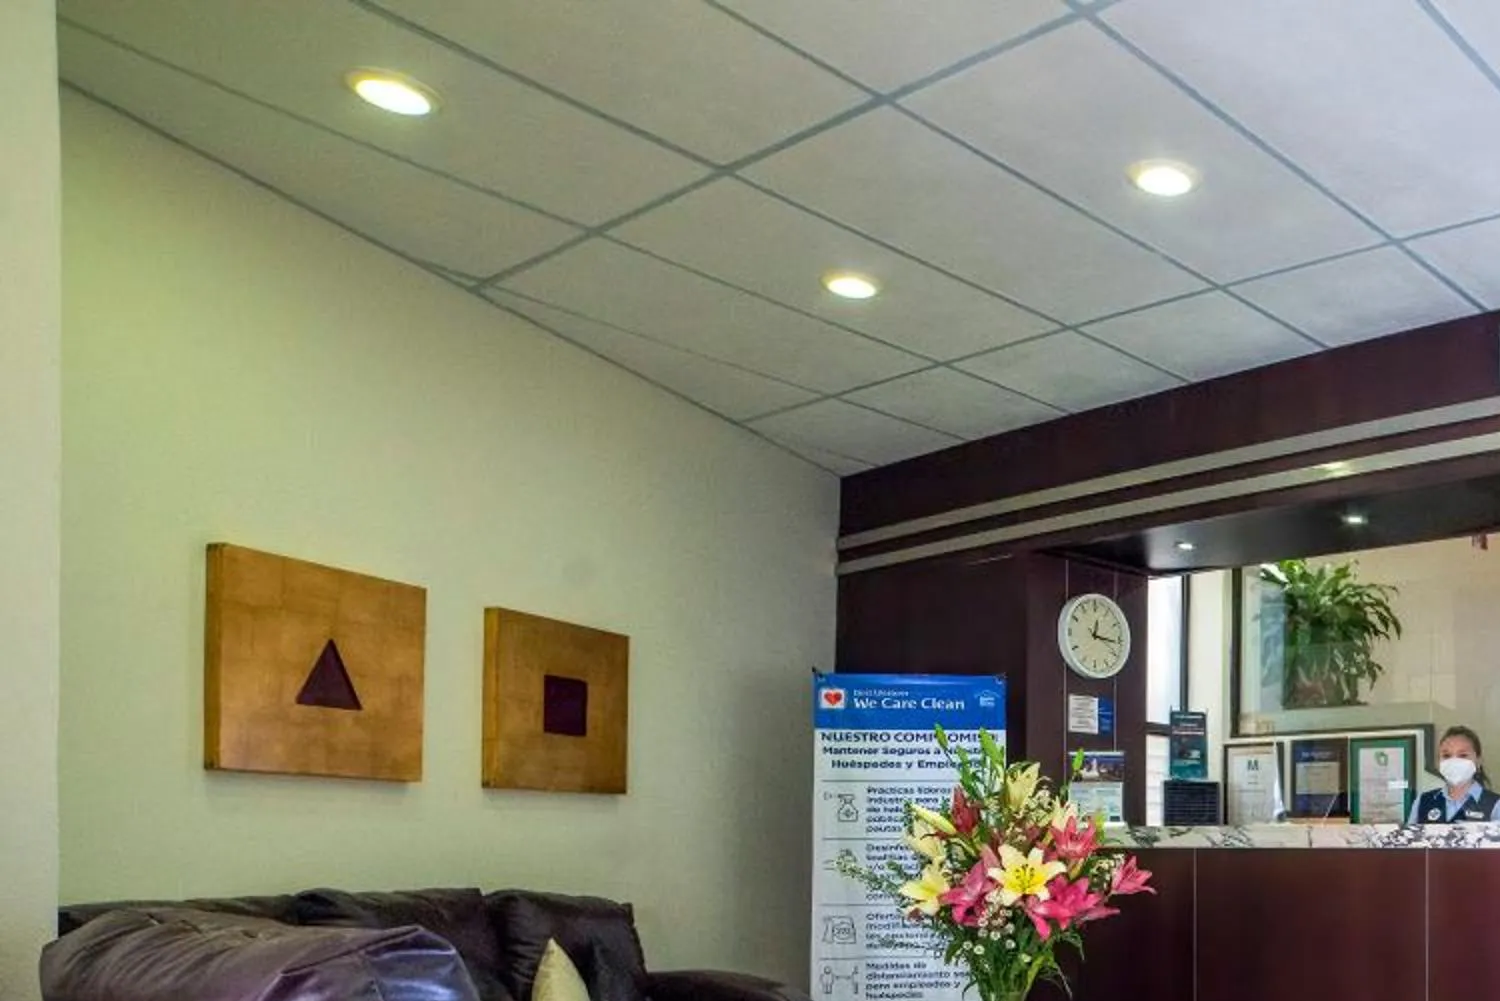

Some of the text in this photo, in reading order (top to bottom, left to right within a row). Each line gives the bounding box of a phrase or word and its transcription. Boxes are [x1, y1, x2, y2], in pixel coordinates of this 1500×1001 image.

[853, 698, 877, 709] We
[881, 698, 917, 709] Care
[921, 697, 965, 710] Clean
[821, 731, 891, 743] NUESTRO
[823, 746, 878, 755] Mantener
[882, 746, 931, 756] Seguros
[905, 761, 913, 769] y
